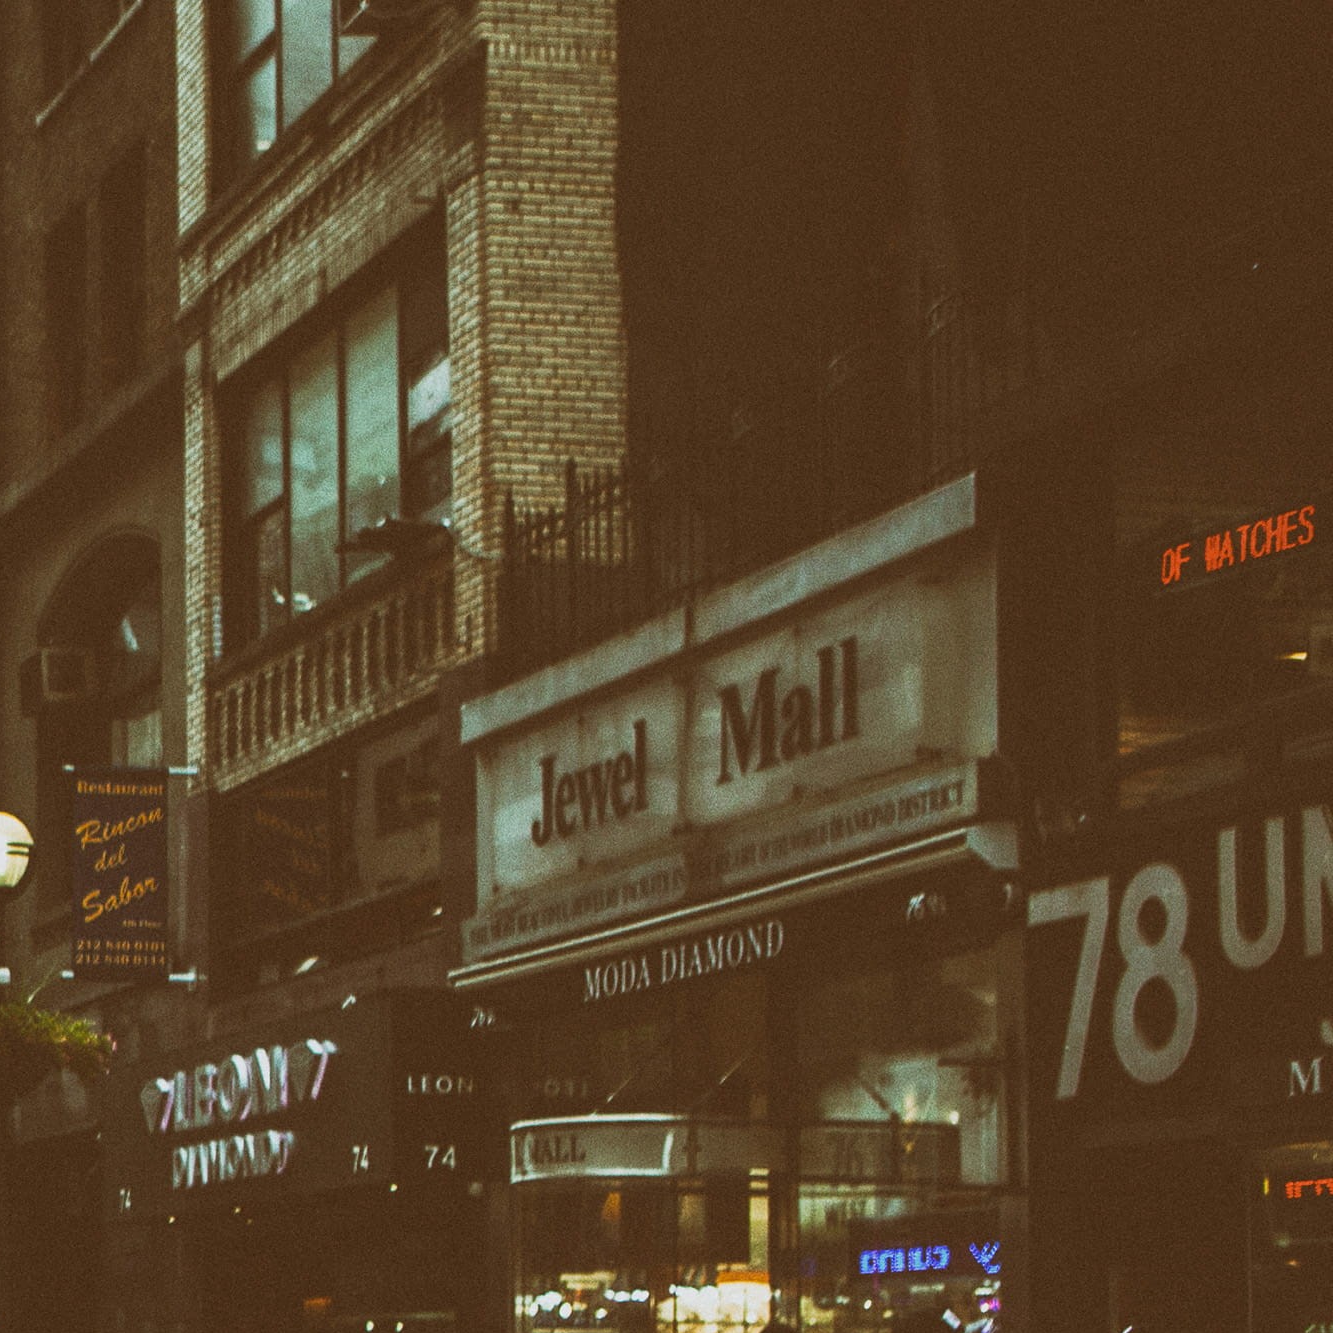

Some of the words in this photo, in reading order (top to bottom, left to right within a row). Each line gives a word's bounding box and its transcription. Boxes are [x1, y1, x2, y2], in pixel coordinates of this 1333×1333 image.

[1161, 542, 1191, 586] OF
[1204, 504, 1315, 574] WATCHES
[532, 718, 648, 849] Jewel
[715, 635, 861, 787] Mall
[76, 780, 164, 796] Restaurant
[75, 807, 164, 851] Rincon
[93, 843, 128, 872] del
[81, 876, 159, 925] Sabor
[583, 955, 652, 1004] MODA
[661, 920, 785, 985] DIAMOND
[1027, 862, 1199, 1103] 78
[424, 1144, 456, 1171] 74
